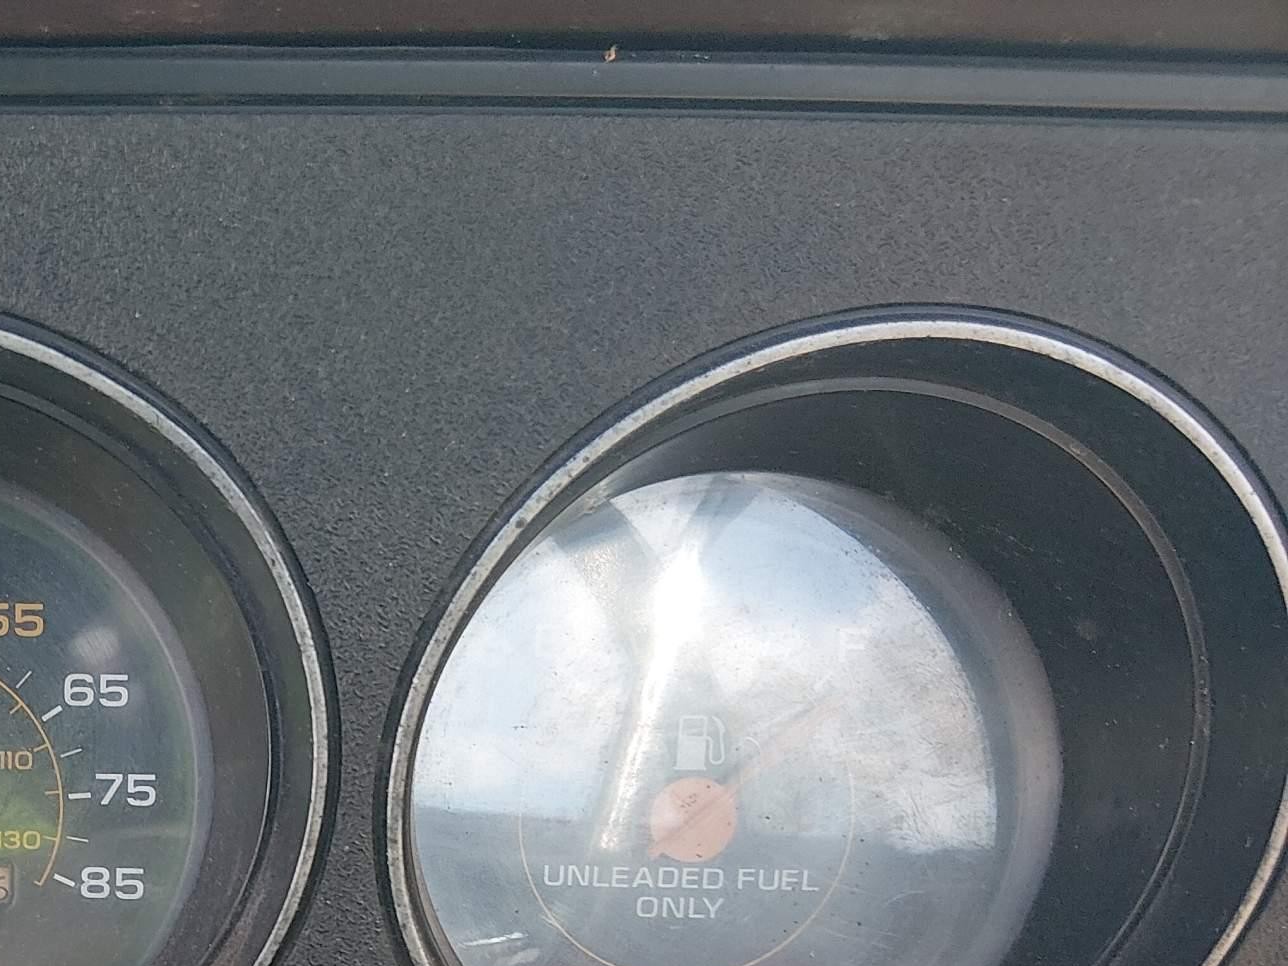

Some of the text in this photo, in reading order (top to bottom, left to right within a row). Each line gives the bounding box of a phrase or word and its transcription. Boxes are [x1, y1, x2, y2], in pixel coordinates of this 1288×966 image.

[63, 674, 129, 708] 65
[95, 774, 157, 807] 75
[79, 866, 145, 900] 85
[543, 864, 820, 891] UNLEADED FUEL
[636, 896, 725, 918] ONLY
